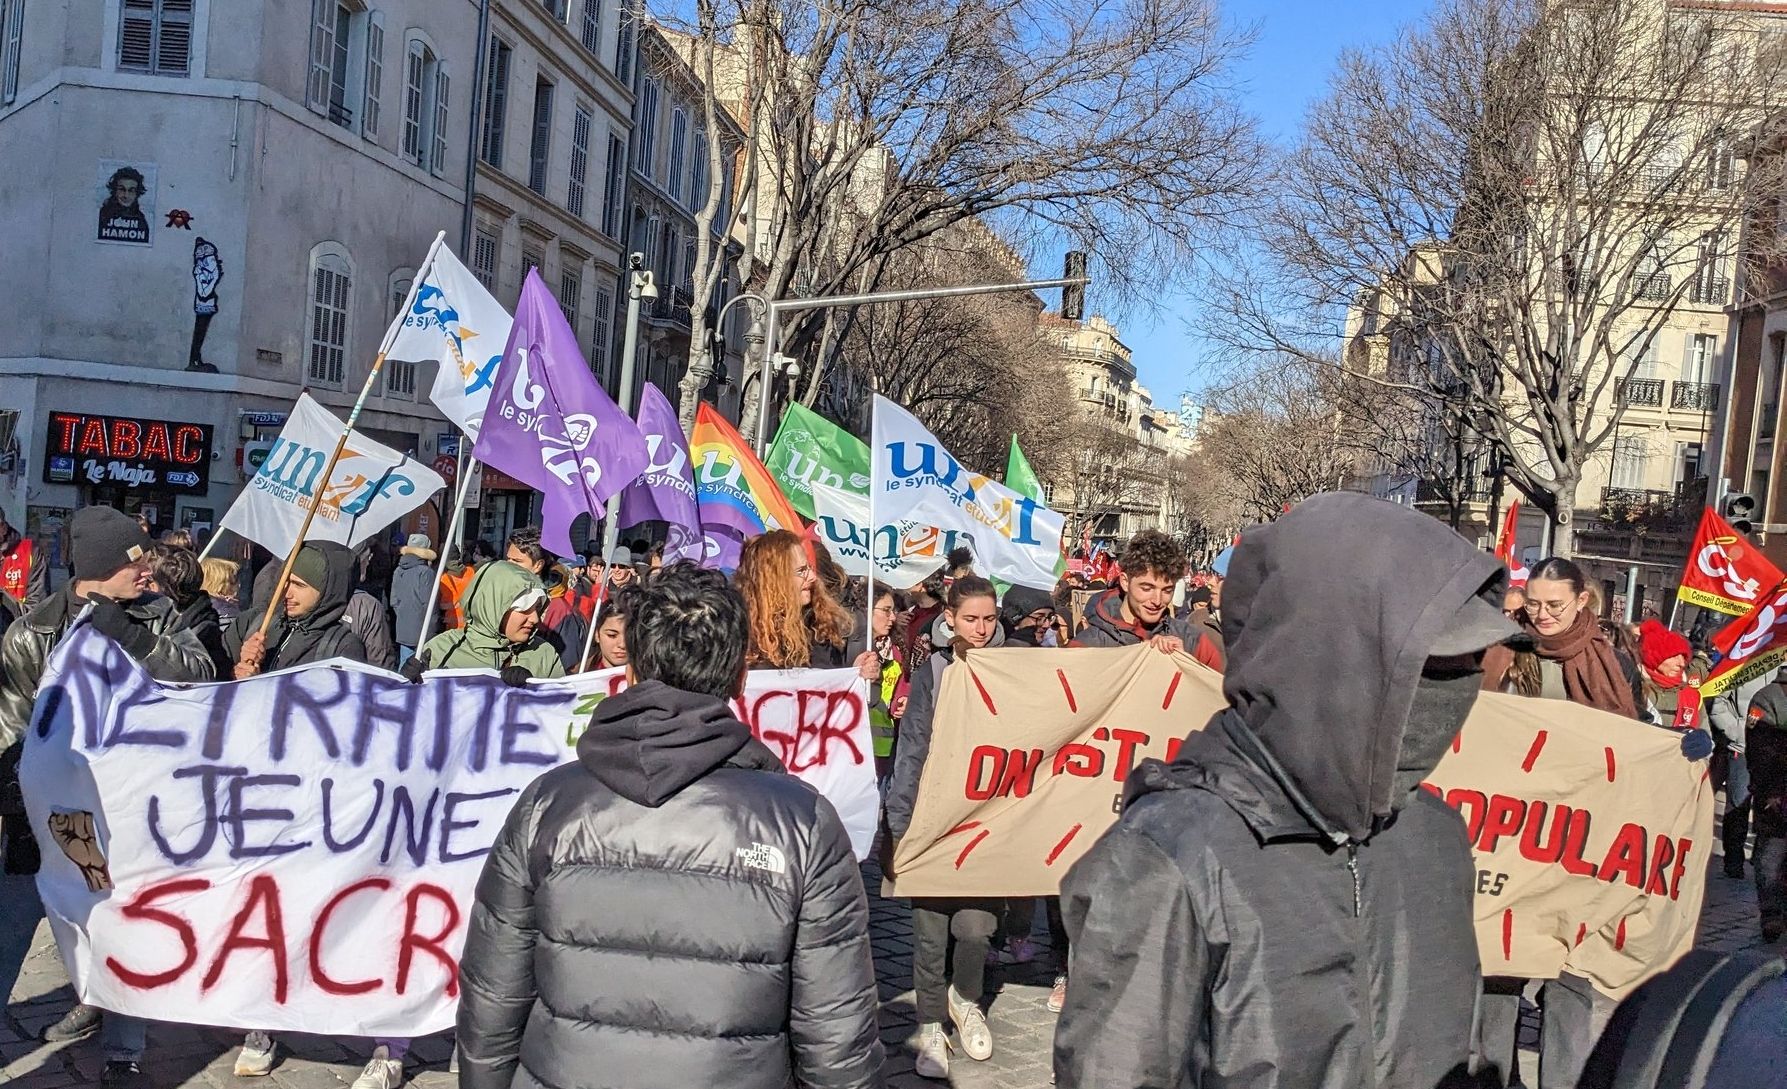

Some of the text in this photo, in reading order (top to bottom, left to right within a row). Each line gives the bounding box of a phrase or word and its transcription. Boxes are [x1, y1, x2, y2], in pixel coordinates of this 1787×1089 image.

[102, 228, 145, 240] HAMON
[55, 414, 203, 464] TABAC
[83, 459, 156, 487] Le Naja
[886, 479, 900, 491] le
[254, 475, 340, 522] syndicat etuiant
[5, 569, 21, 581] cgt
[1691, 590, 1715, 605] Conseil
[965, 744, 1043, 800] ON
[148, 765, 520, 866] JEUNE
[735, 847, 769, 862] NORTH
[752, 841, 770, 854] THE
[1420, 782, 1692, 901] OPULARE
[744, 858, 768, 870] FACE
[1477, 869, 1509, 896] ES
[106, 875, 458, 1004] SACR
